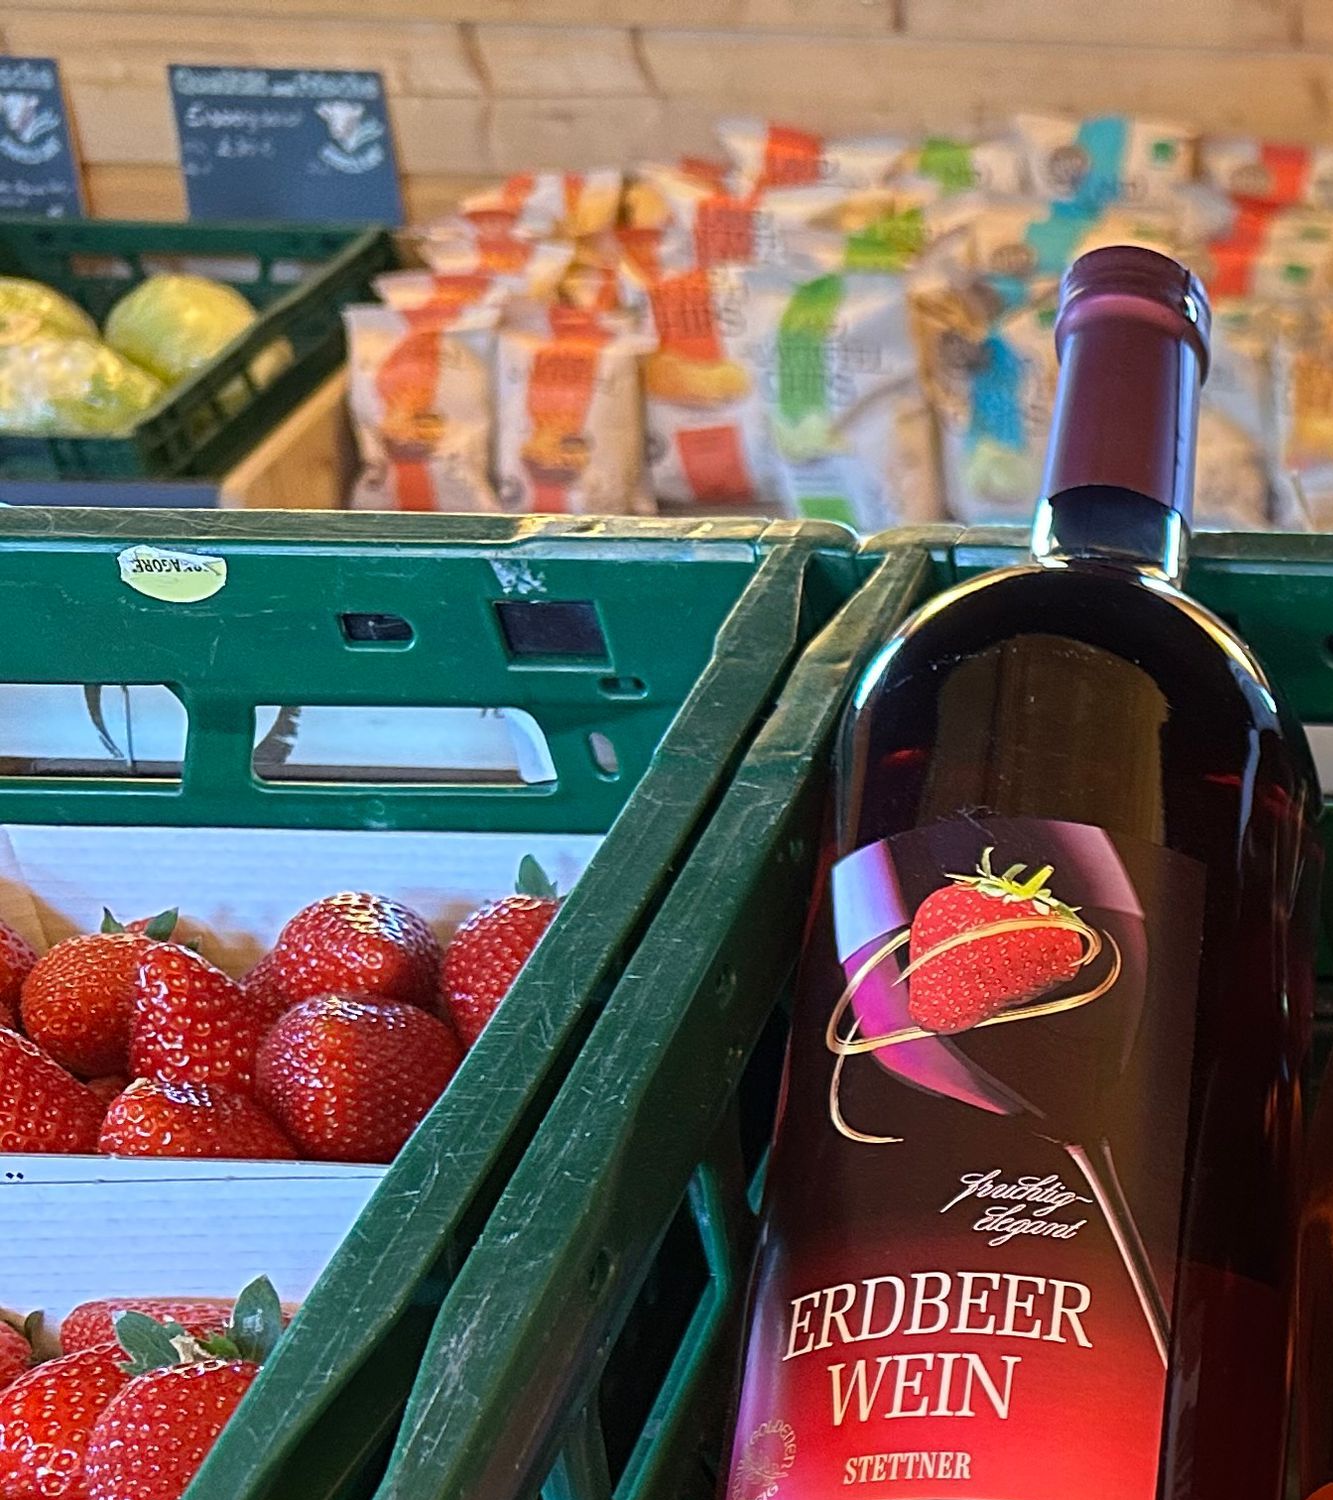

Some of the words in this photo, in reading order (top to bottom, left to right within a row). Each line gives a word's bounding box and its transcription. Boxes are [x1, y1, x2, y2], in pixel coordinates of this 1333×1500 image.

[972, 1203, 1087, 1247] elegant
[782, 1271, 1094, 1362] ERDBEER
[827, 1352, 1022, 1427] WEIN
[843, 1452, 971, 1485] STETTNER
